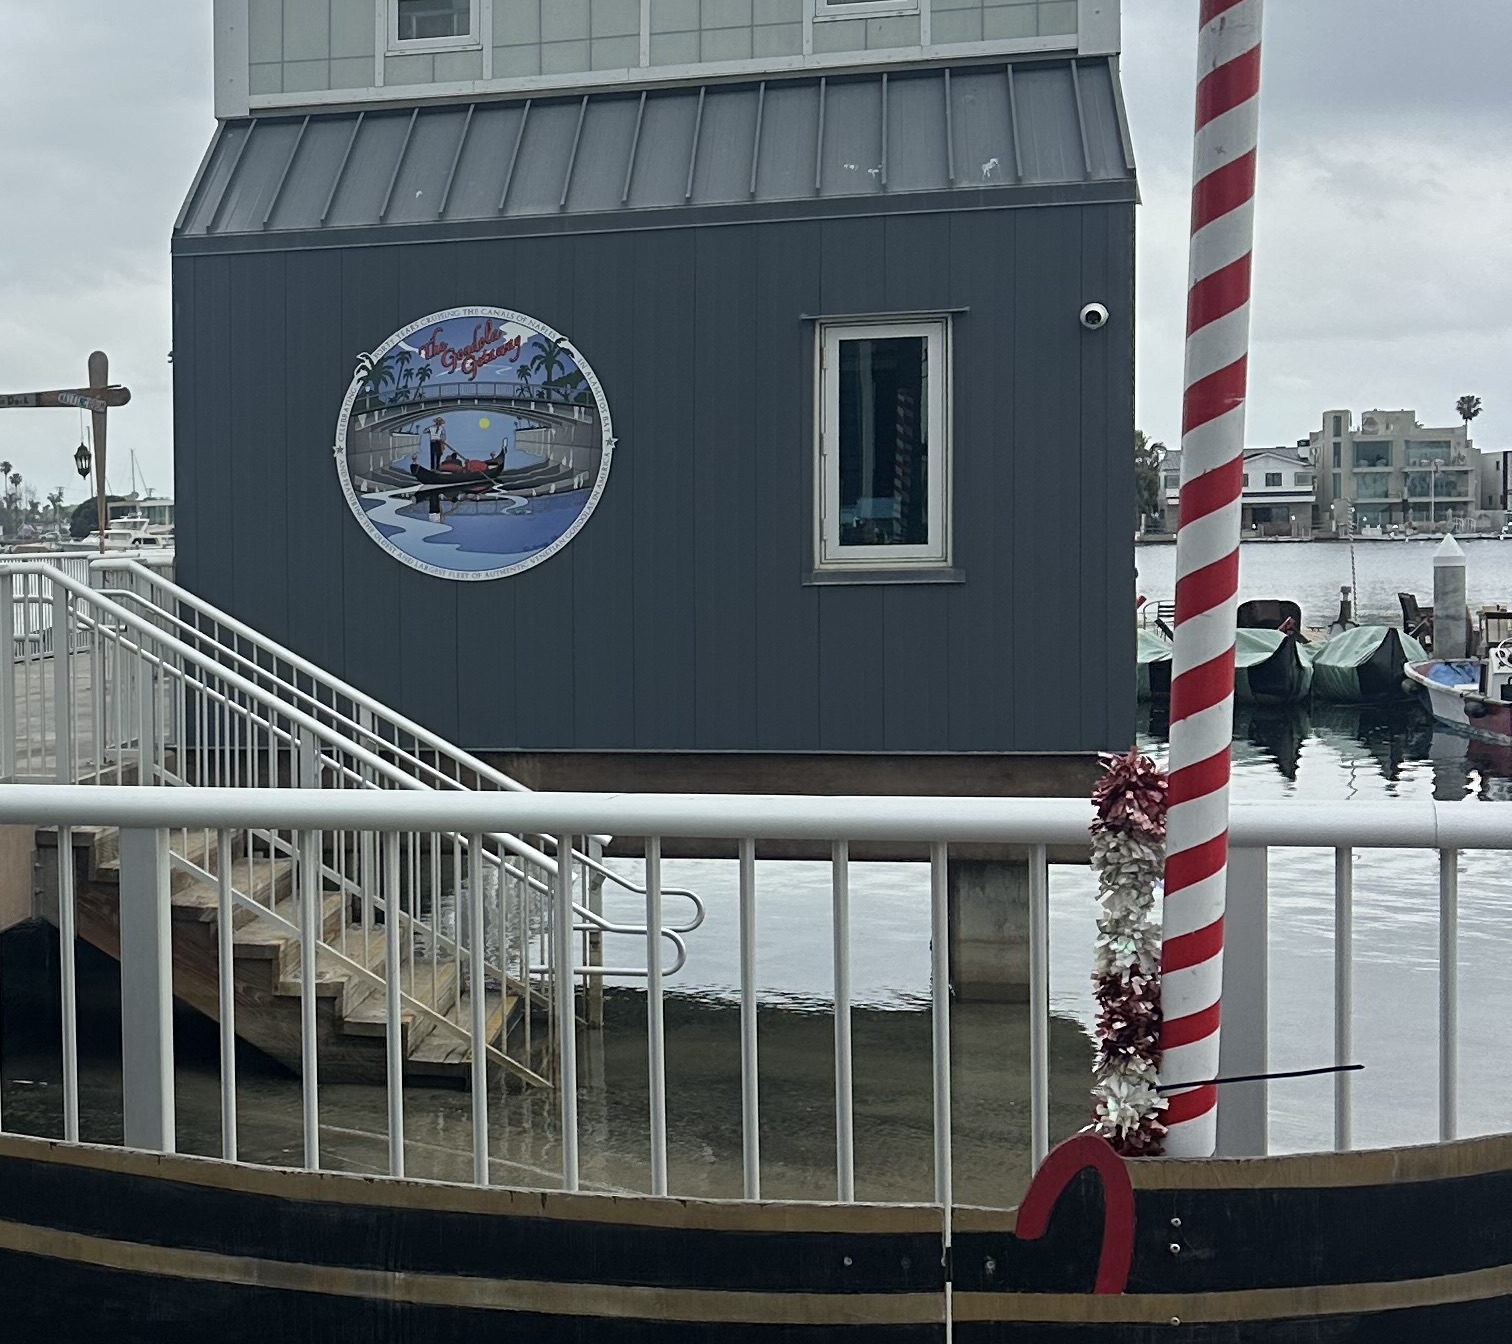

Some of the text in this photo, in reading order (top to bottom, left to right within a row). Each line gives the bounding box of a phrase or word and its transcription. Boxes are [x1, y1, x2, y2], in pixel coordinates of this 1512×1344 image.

[419, 327, 448, 360] The
[441, 319, 506, 374] Gondola
[461, 335, 521, 381] Getaway
[338, 387, 356, 442] CELEBRATING
[373, 340, 395, 359] FORTY
[396, 321, 419, 339] YEARS
[420, 309, 460, 325] CRUISING
[481, 308, 514, 319] CANALS
[516, 313, 527, 322] OF
[528, 319, 557, 339] NAPLES
[578, 358, 587, 369] IN
[585, 370, 608, 413] ALAMITOS
[603, 416, 611, 433] BAY
[340, 459, 349, 476] AND
[597, 453, 611, 488] AMERICA
[343, 476, 367, 521] FEATURING
[592, 490, 601, 500] IN
[363, 519, 377, 536] THE
[567, 501, 594, 539] GONDOLAS
[374, 533, 396, 554] OLDEST
[529, 539, 566, 564] VENETIAN
[398, 551, 415, 566] AND
[415, 559, 446, 576] LARGEST
[472, 571, 482, 579] OF
[485, 564, 527, 578] AUTHENTIC
